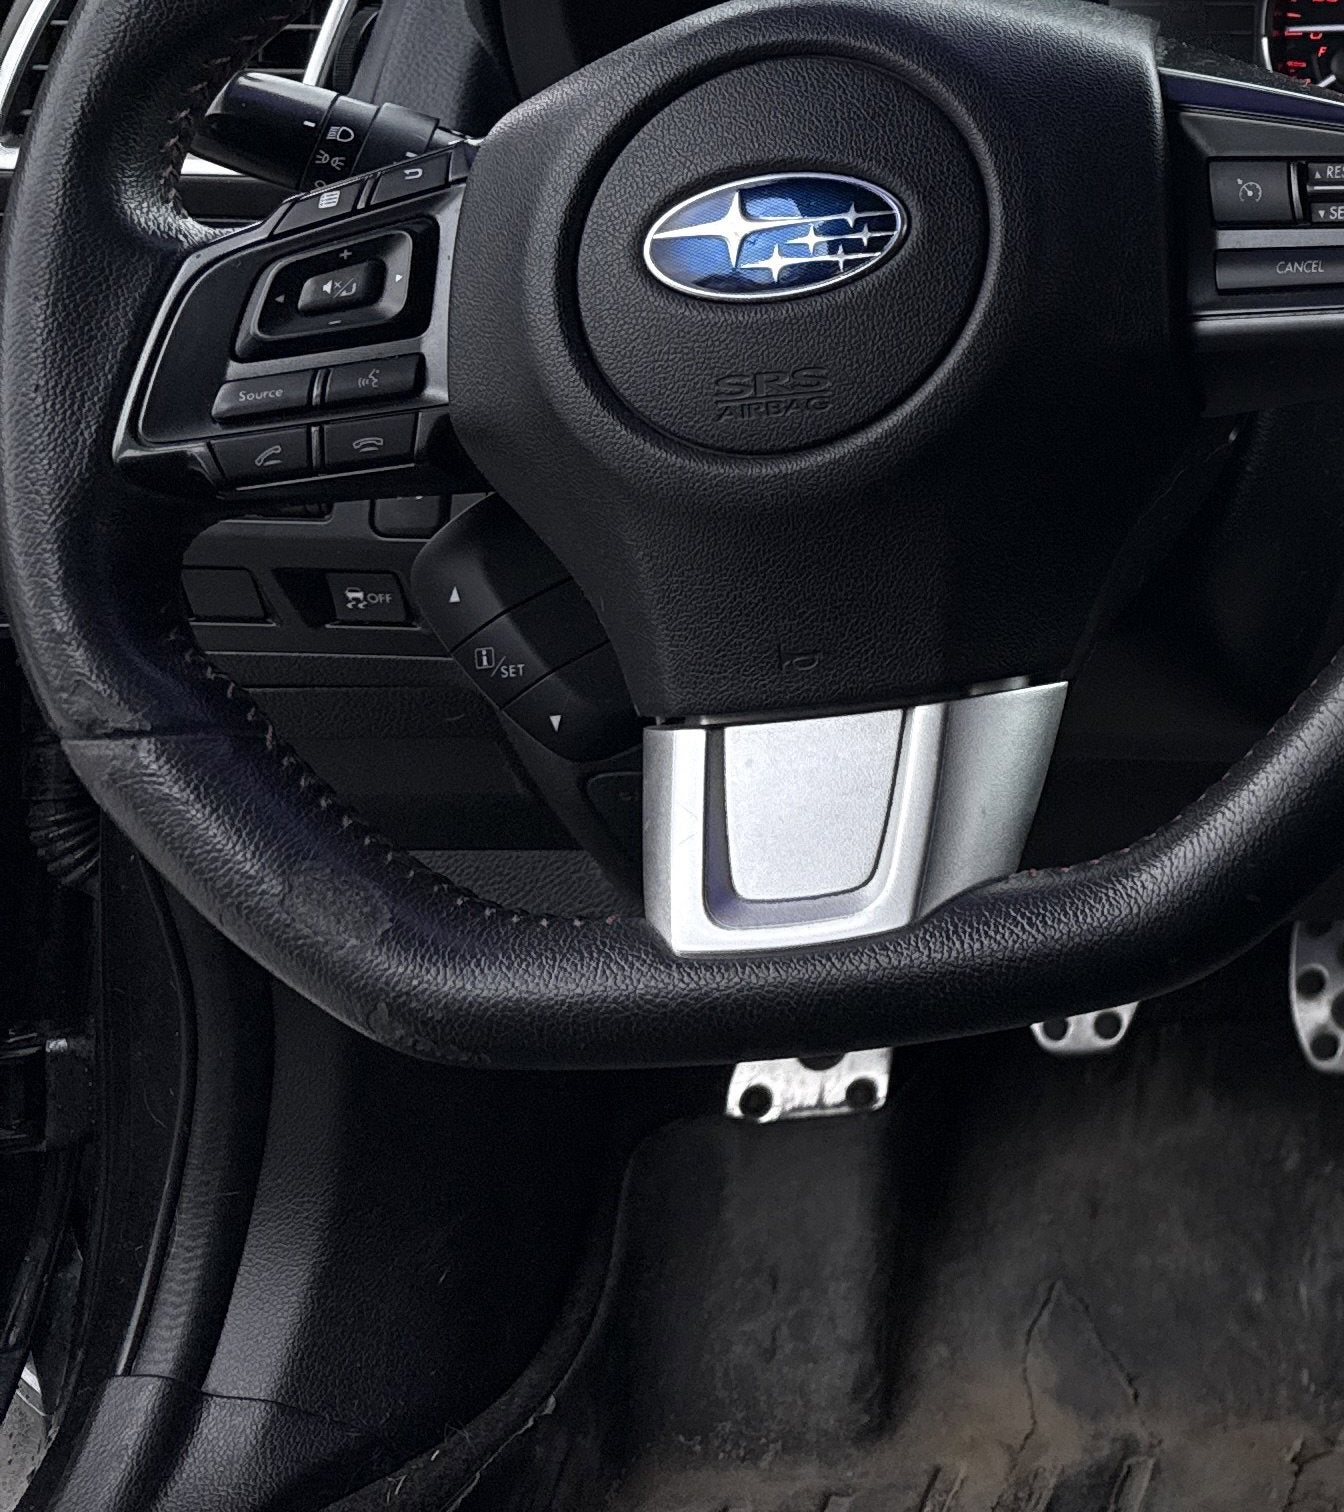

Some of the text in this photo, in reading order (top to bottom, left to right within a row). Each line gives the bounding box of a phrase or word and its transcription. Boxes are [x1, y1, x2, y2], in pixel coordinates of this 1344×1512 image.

[1276, 260, 1325, 275] CANCEL
[714, 367, 832, 398] SRS
[238, 389, 284, 402] Source
[716, 396, 832, 421] AIRBAG
[366, 592, 393, 605] OFF
